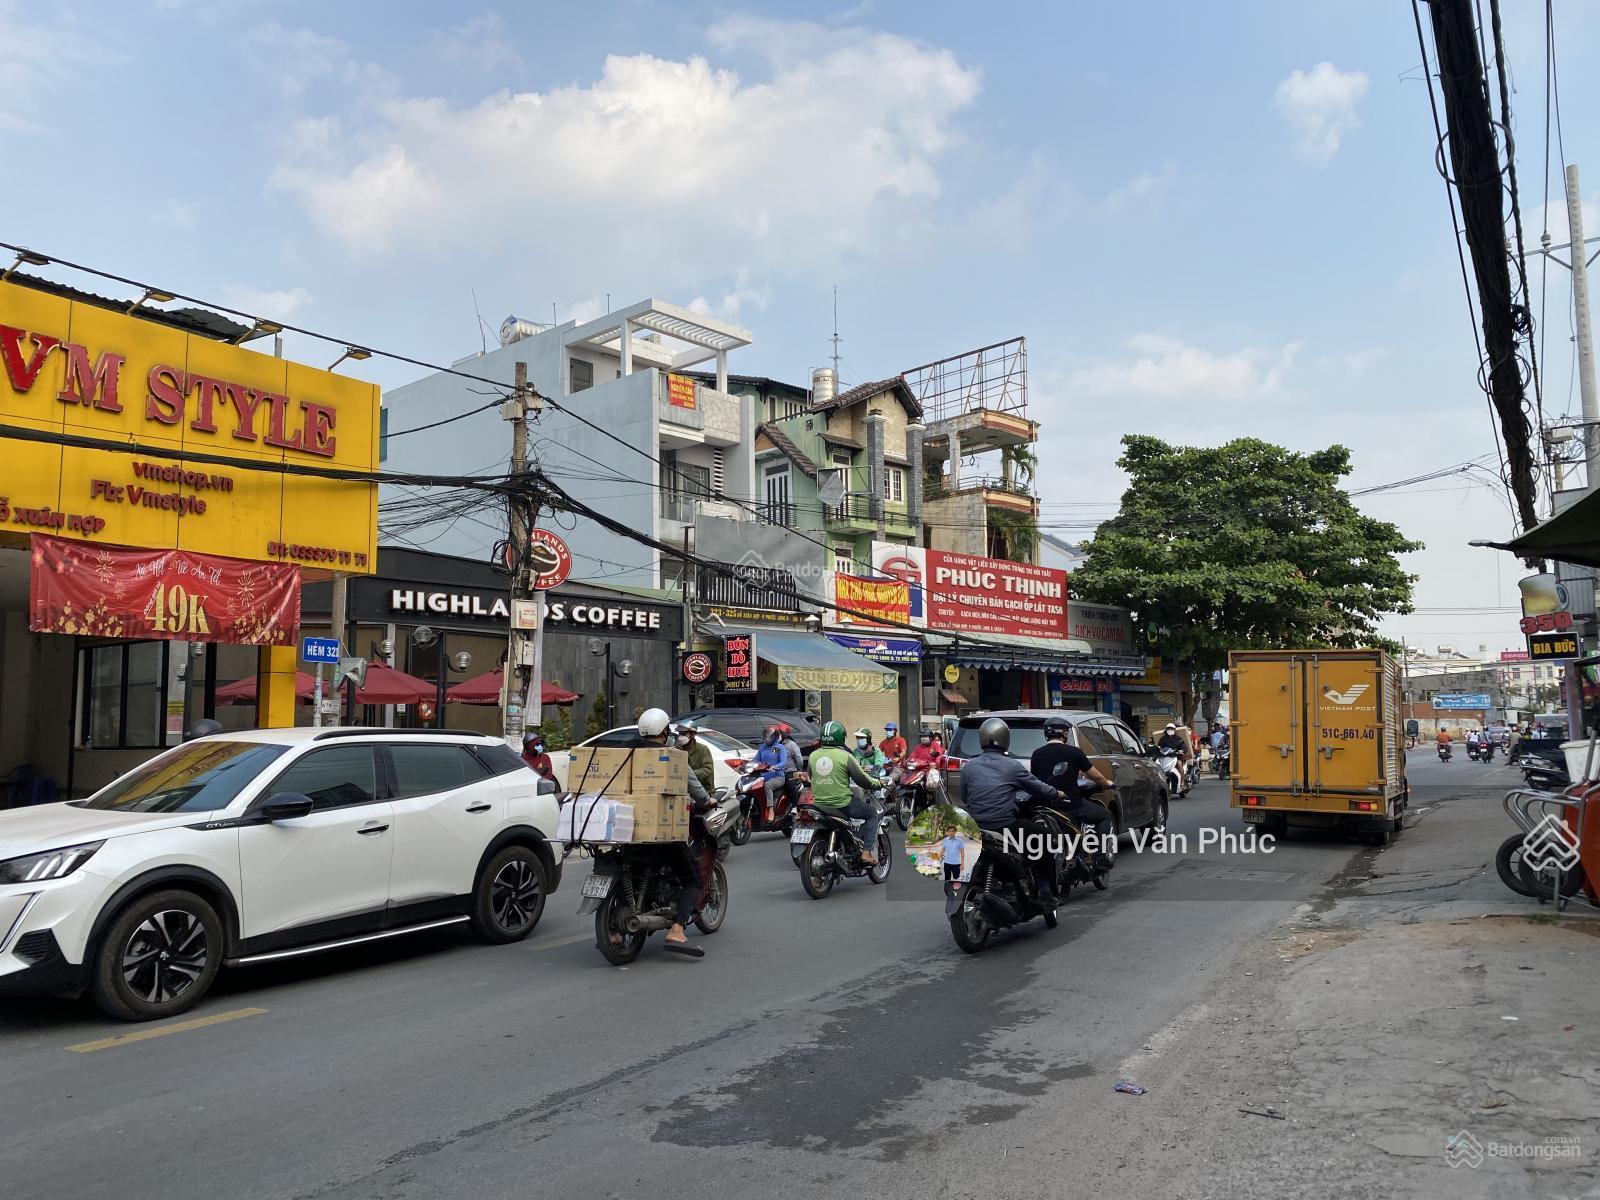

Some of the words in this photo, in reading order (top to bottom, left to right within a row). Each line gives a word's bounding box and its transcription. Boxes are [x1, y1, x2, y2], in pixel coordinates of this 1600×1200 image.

[0, 324, 126, 413] VM
[146, 364, 338, 458] STYLE
[13, 506, 66, 529] XUÂN
[67, 513, 106, 536] HỢP
[936, 566, 996, 590] PHÚC
[1002, 575, 1062, 600] THỊNH
[959, 593, 988, 606] CHUYÊN
[989, 596, 1004, 608] BÁN
[144, 584, 211, 635] 49K
[391, 589, 566, 622] HIGHLAS
[572, 604, 661, 630] COFFEE
[1520, 612, 1572, 635] 350
[307, 642, 325, 656] HẺM
[728, 638, 749, 651] BÚN
[1534, 642, 1553, 655] BIA
[1554, 638, 1577, 654] ĐỨC
[730, 650, 746, 665] BÒ
[728, 662, 750, 678] HUẾ
[1322, 728, 1374, 740] 51C-661.40
